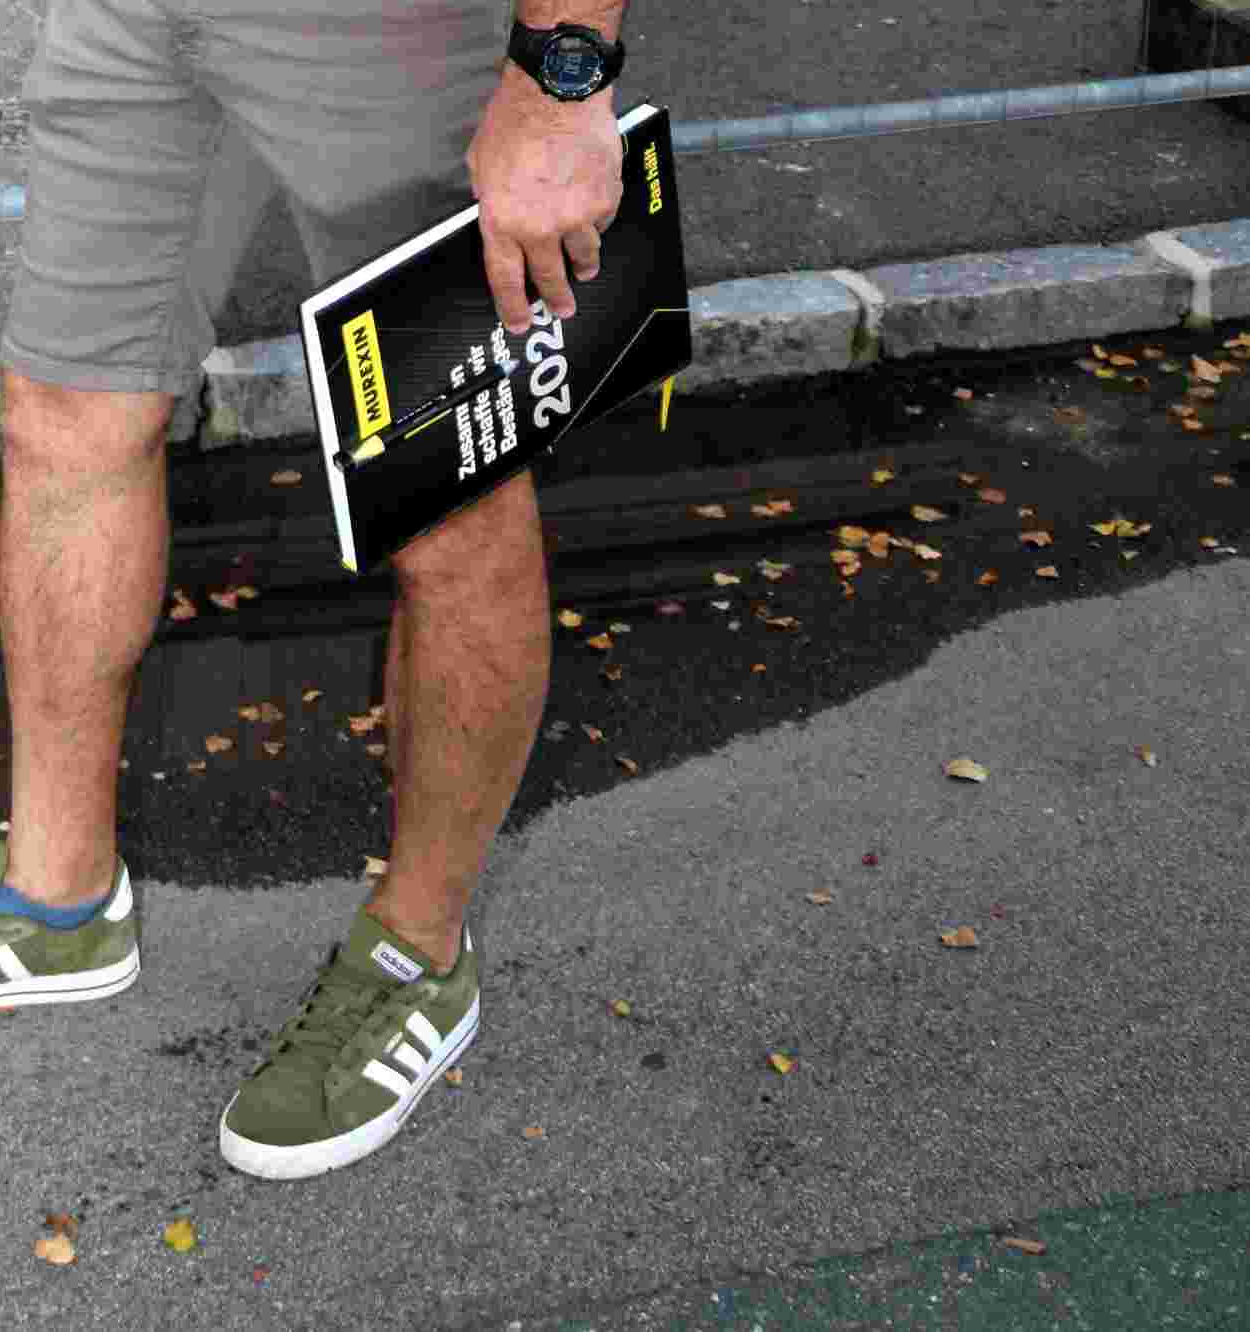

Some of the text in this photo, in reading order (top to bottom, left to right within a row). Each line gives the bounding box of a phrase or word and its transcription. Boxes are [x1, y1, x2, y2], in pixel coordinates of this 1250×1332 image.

[649, 178, 662, 214] Das
[353, 326, 381, 423] MUREXIN
[450, 364, 476, 481] Zusamn
[468, 344, 497, 464] schaffe wir
[491, 322, 518, 455] Bestänges.
